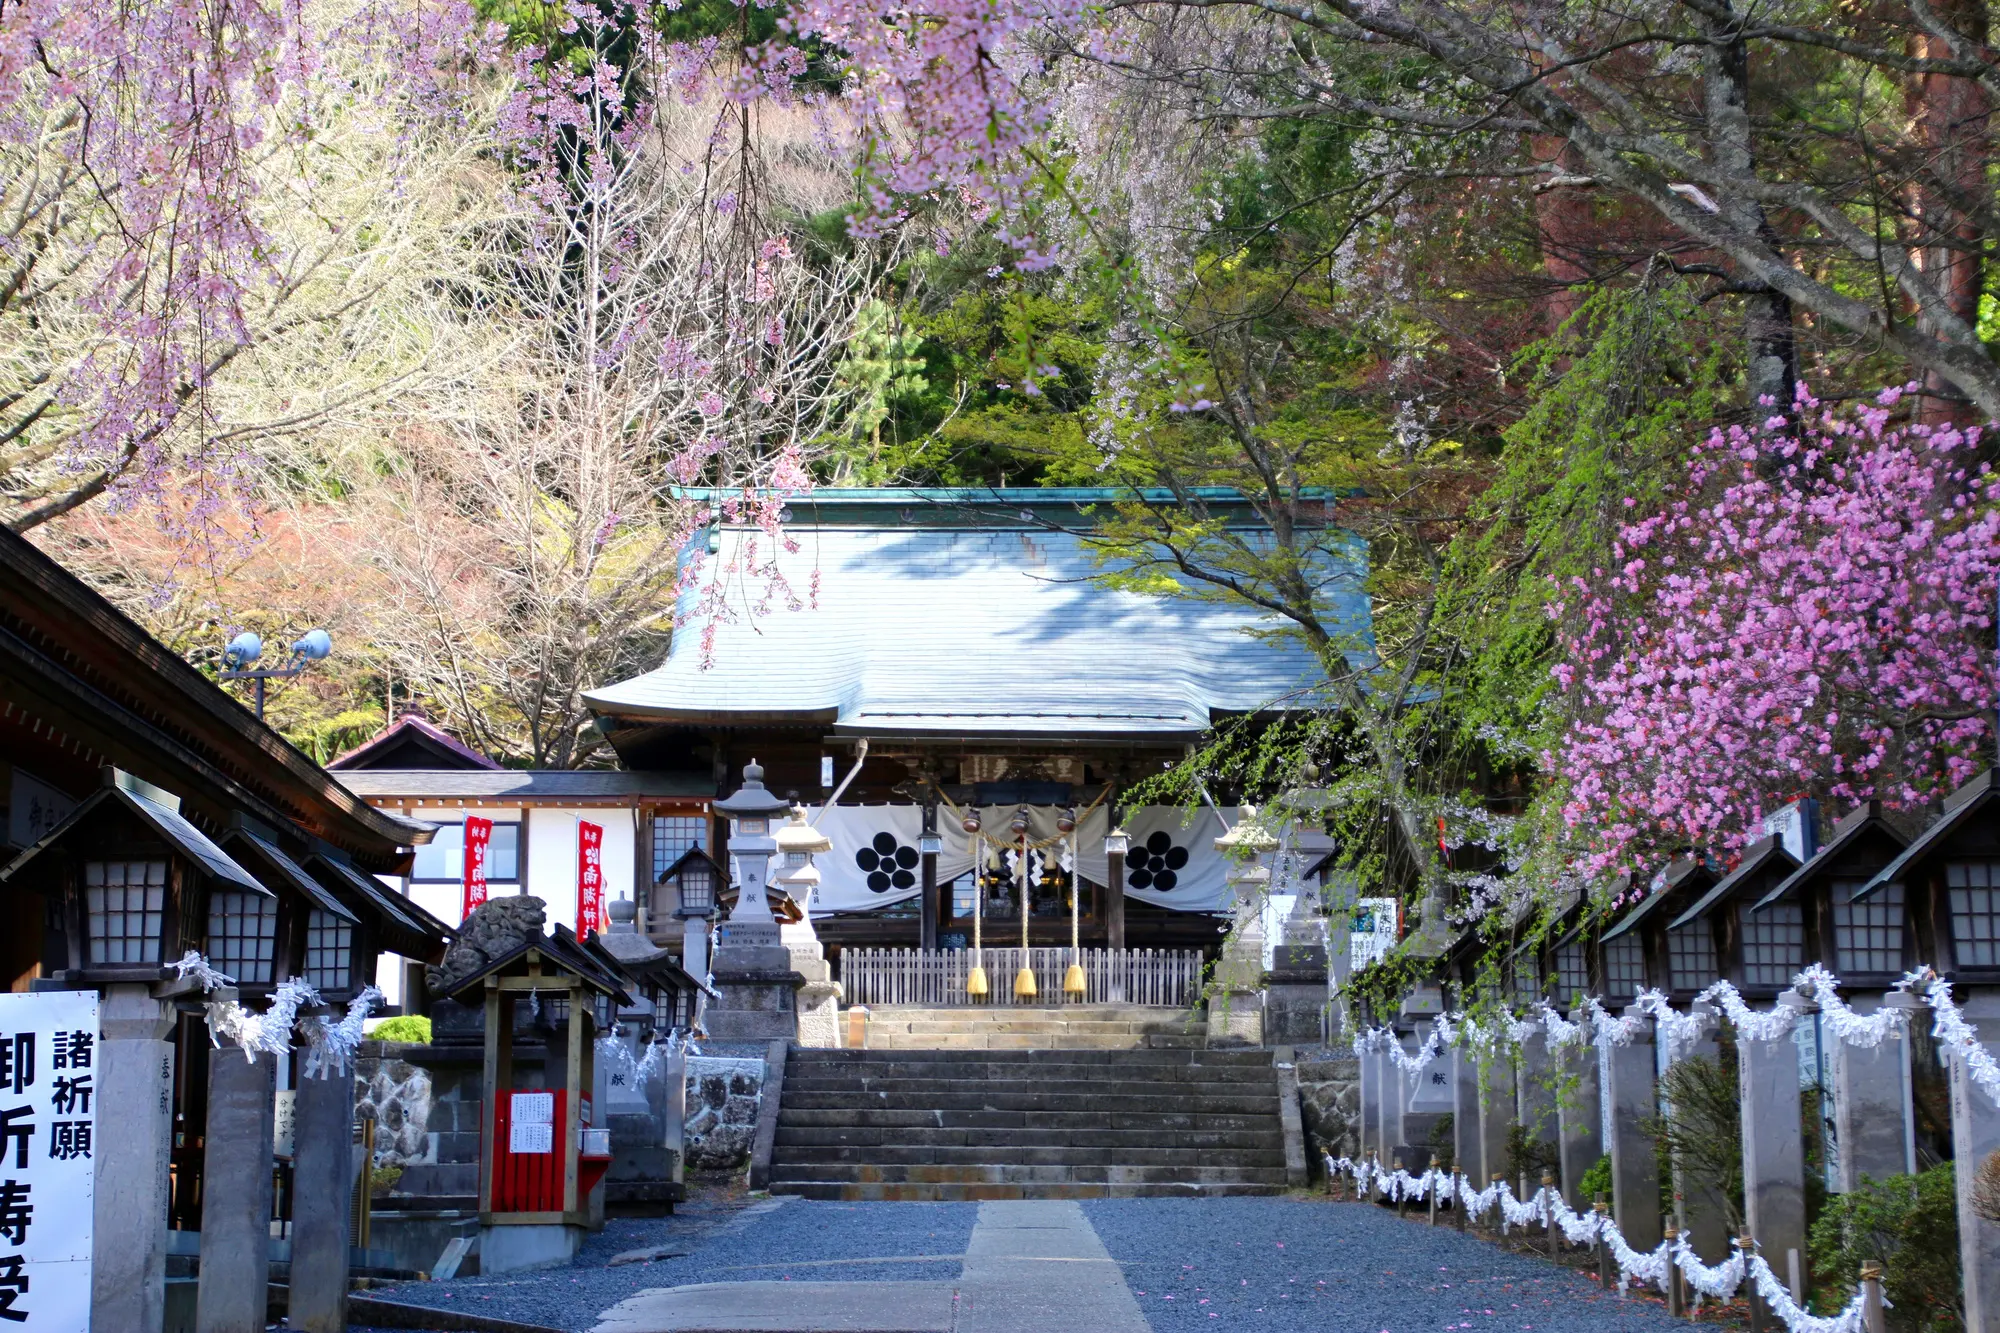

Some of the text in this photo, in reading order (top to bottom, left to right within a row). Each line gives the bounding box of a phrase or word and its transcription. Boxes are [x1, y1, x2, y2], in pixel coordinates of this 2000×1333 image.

[49, 1030, 94, 1160] 諸祈願
[611, 1073, 626, 1087] 献
